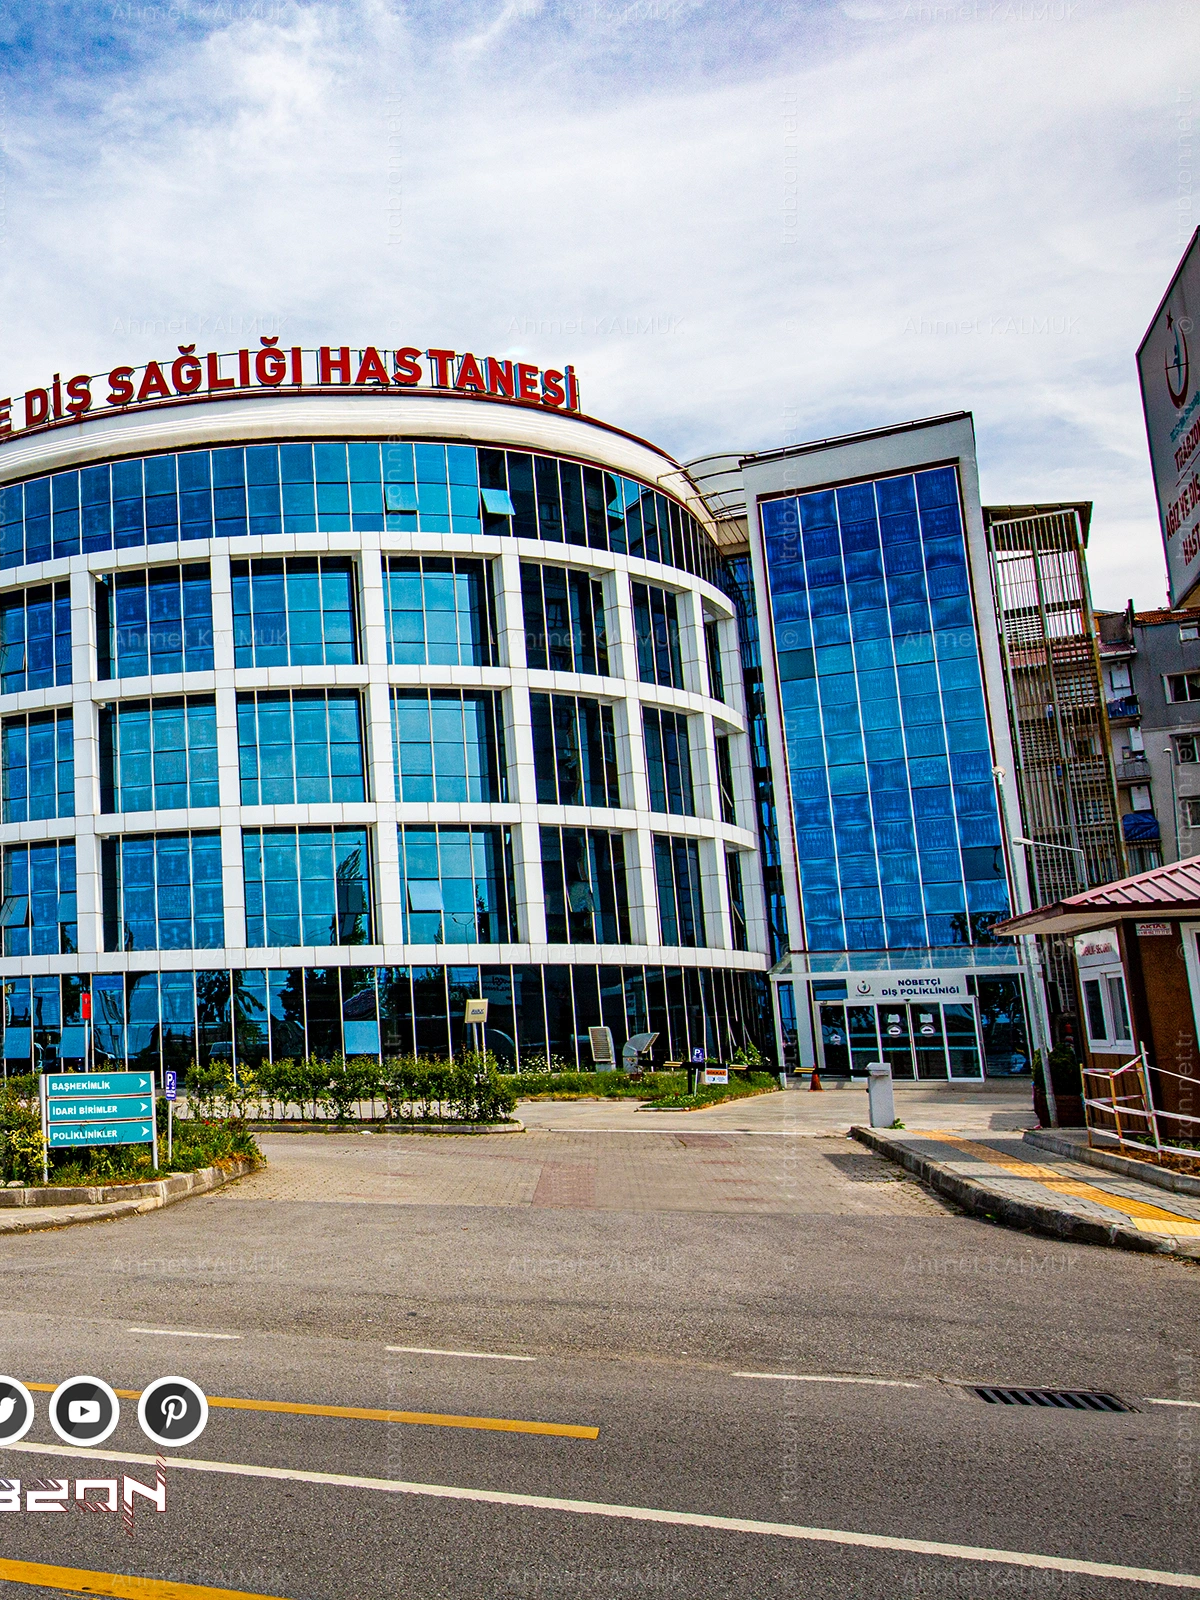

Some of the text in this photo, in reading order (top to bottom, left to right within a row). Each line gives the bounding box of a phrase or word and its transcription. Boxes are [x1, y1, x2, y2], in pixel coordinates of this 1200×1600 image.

[25, 373, 92, 427] DİŞ
[106, 336, 303, 405] SAĞLIĞI
[319, 346, 578, 410] HASTANESİ
[1179, 489, 1190, 520] VE
[898, 978, 941, 986] NÖBETÇİ
[882, 986, 960, 996] DİŞ POLİKLİNİĞİ
[168, 1073, 173, 1086] P
[52, 1081, 110, 1092] BAŞHEKİMLİK
[52, 1105, 118, 1116] İDARİ BİRİMLER
[52, 1129, 118, 1140] POLİKLİNİKLER
